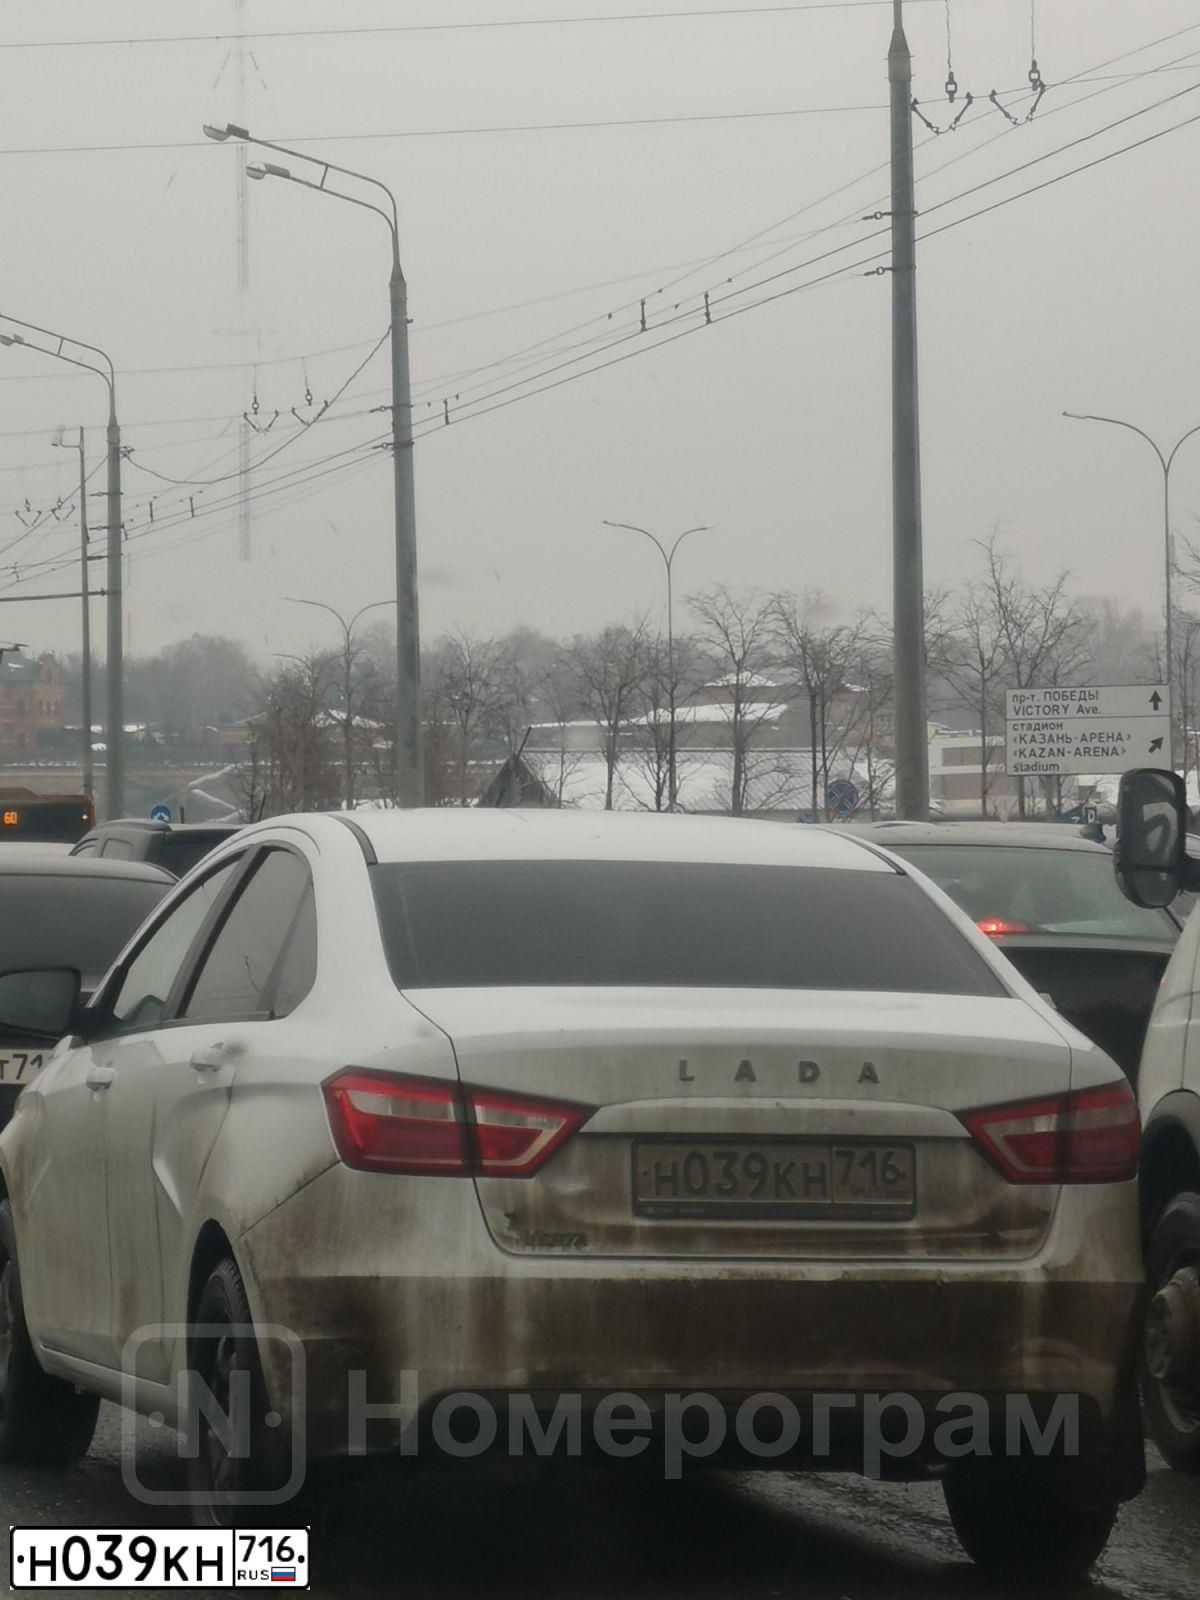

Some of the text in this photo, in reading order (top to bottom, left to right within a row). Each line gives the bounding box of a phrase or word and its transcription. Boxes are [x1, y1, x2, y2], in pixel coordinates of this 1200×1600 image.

[1043, 690, 1099, 702] ПОБЕДЫ
[1013, 704, 1102, 716] VICTORY Ave.
[1012, 722, 1063, 732] стадион
[1013, 761, 1060, 772] stadium
[4, 811, 18, 824] 60
[678, 1059, 880, 1083] LADA
[653, 1150, 901, 1197] Н039КН 716
